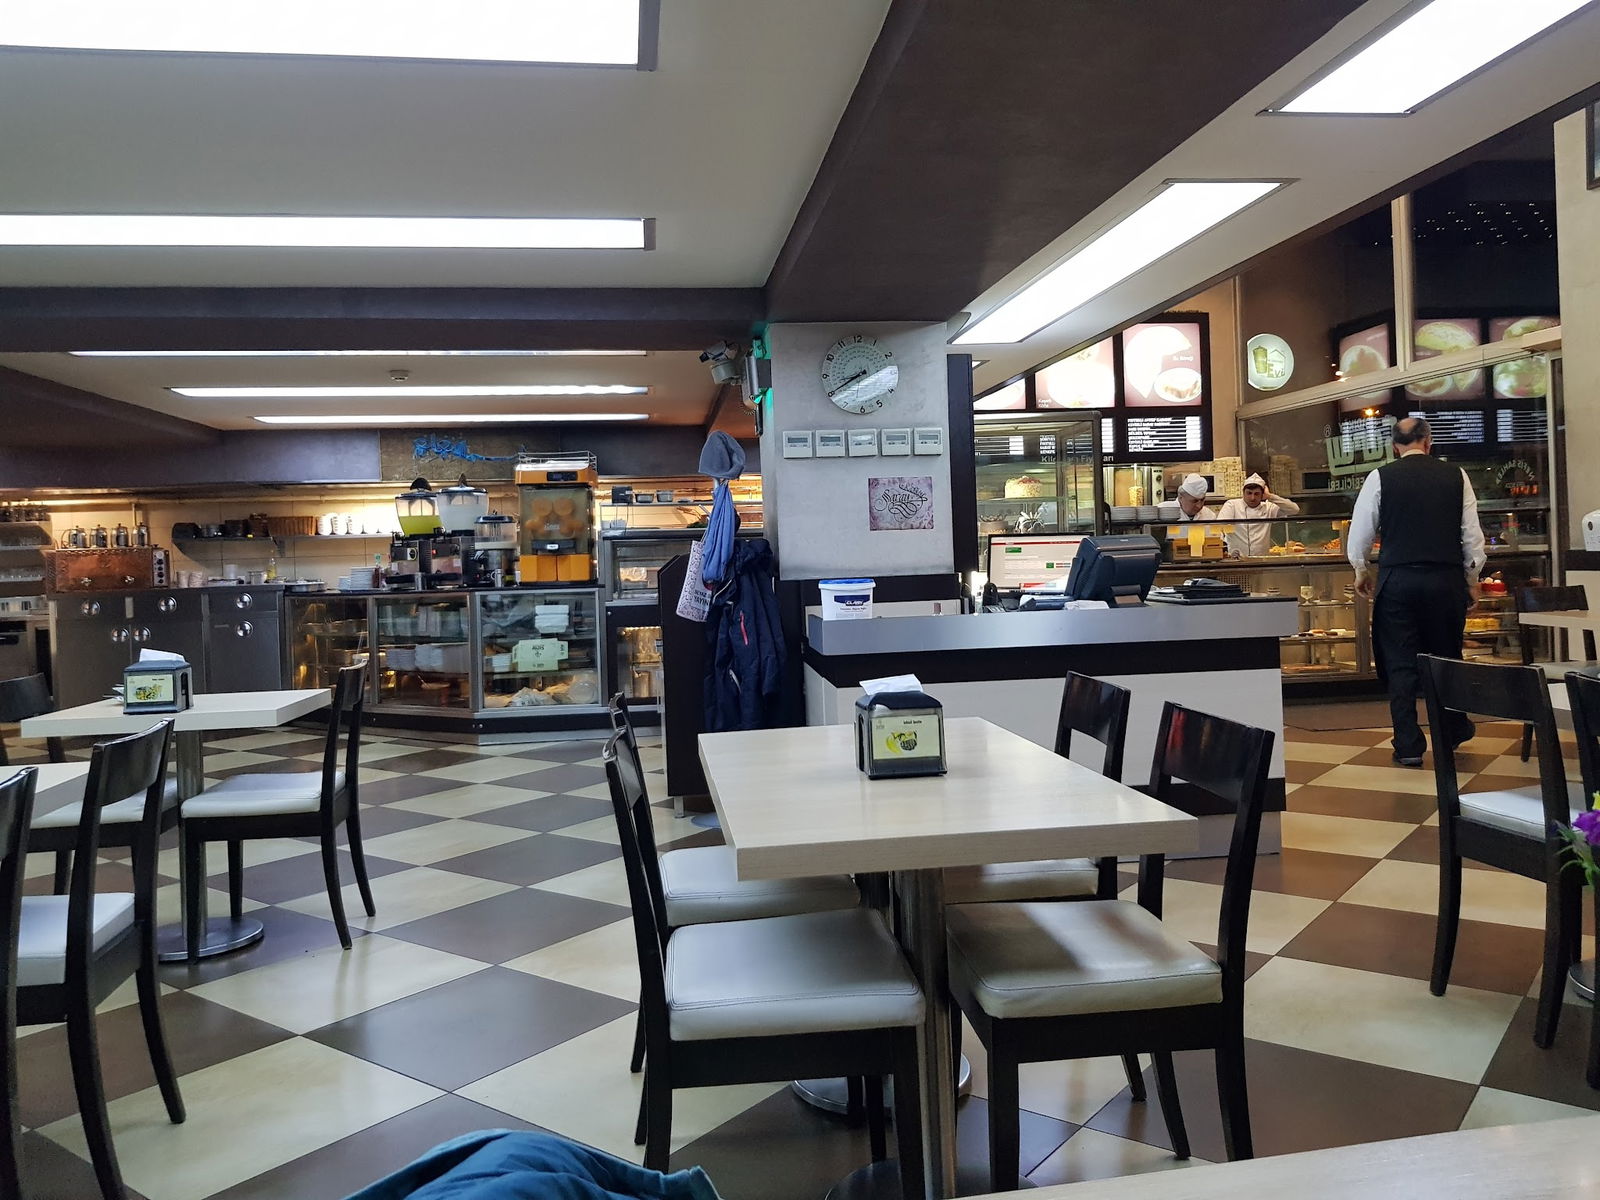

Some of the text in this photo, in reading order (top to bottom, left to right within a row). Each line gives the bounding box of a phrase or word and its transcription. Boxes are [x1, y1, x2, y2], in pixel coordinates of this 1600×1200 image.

[853, 335, 863, 343] 12
[873, 338, 878, 346] 1
[837, 339, 846, 349] 11
[825, 353, 835, 363] 10
[884, 351, 893, 360] 2
[827, 390, 836, 398] 8
[887, 386, 895, 394] 4
[842, 401, 849, 409] 7
[875, 399, 883, 408] 5
[859, 405, 866, 414] 6
